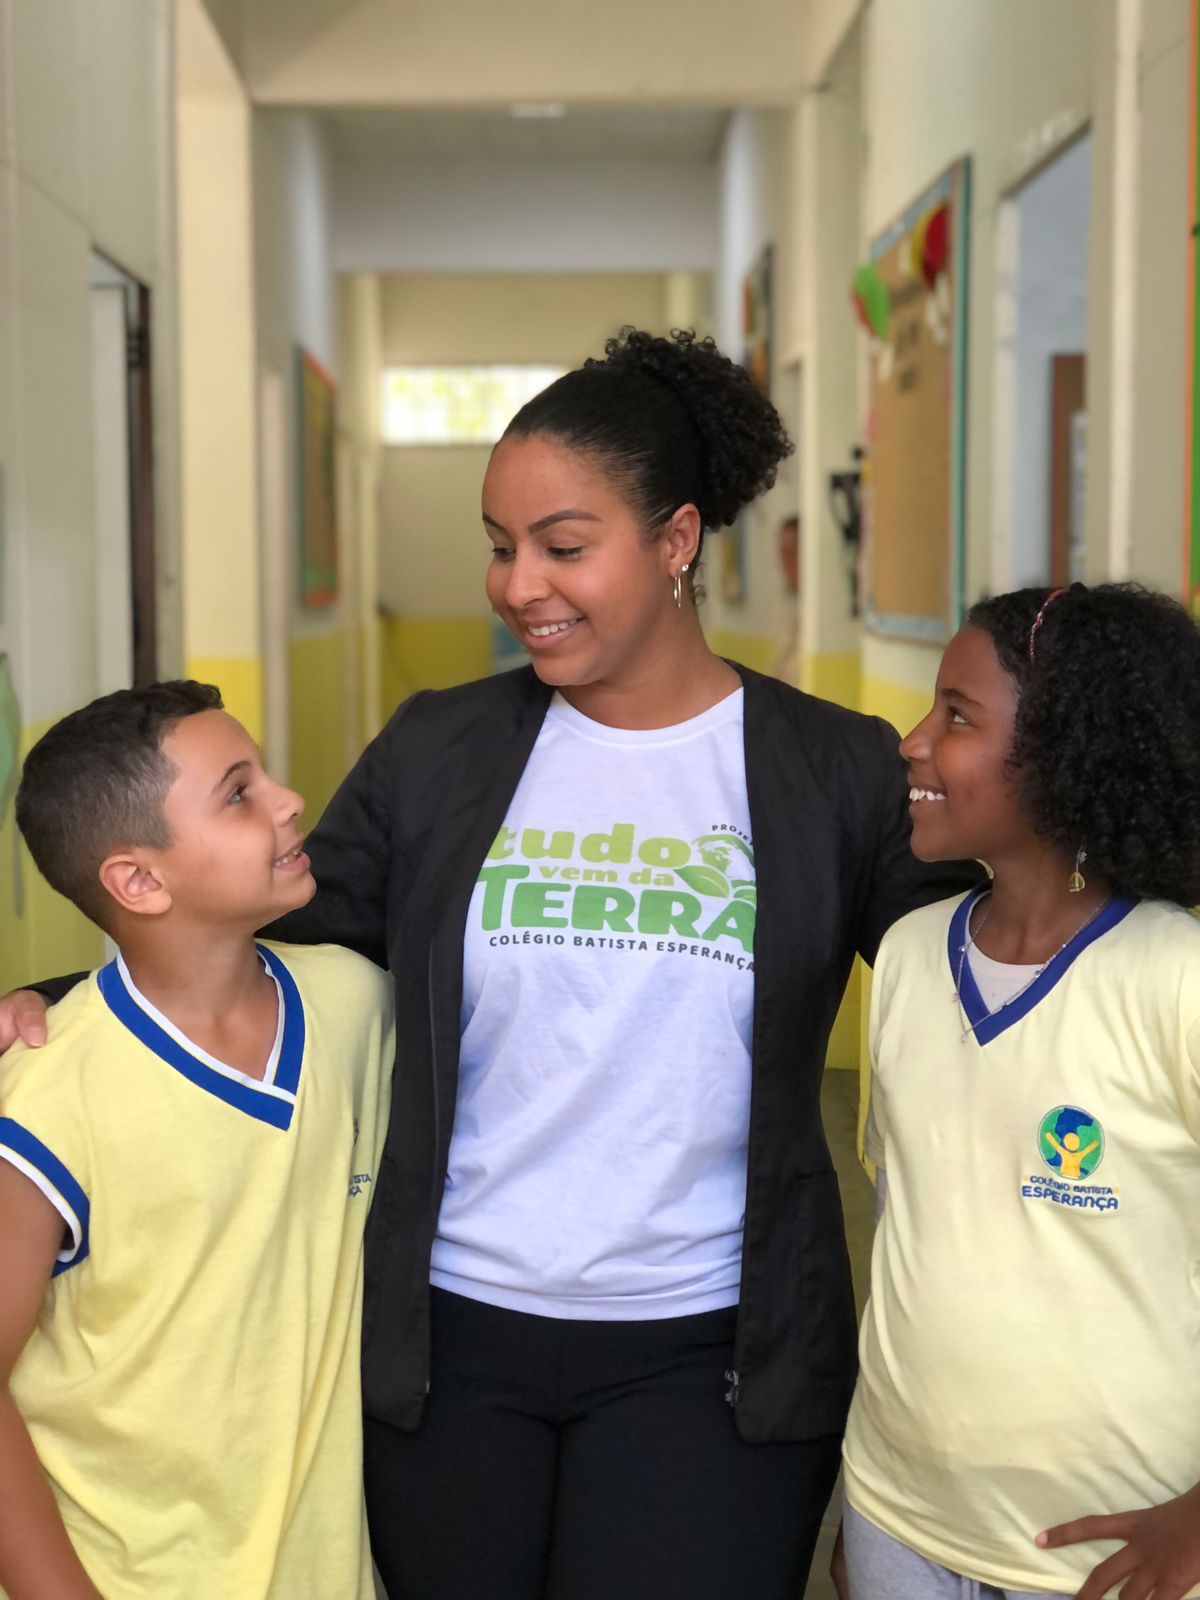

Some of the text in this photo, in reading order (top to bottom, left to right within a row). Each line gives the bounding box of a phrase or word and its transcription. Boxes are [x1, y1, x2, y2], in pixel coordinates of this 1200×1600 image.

[486, 823, 691, 868] tudo
[538, 865, 675, 886] vem da
[475, 864, 757, 954] TERRA
[489, 931, 754, 973] COLÉGIO BATISTA ESPERANÇA
[1021, 1185, 1119, 1211] ESPERANÇA
[1073, 1185, 1114, 1195] BATISTA
